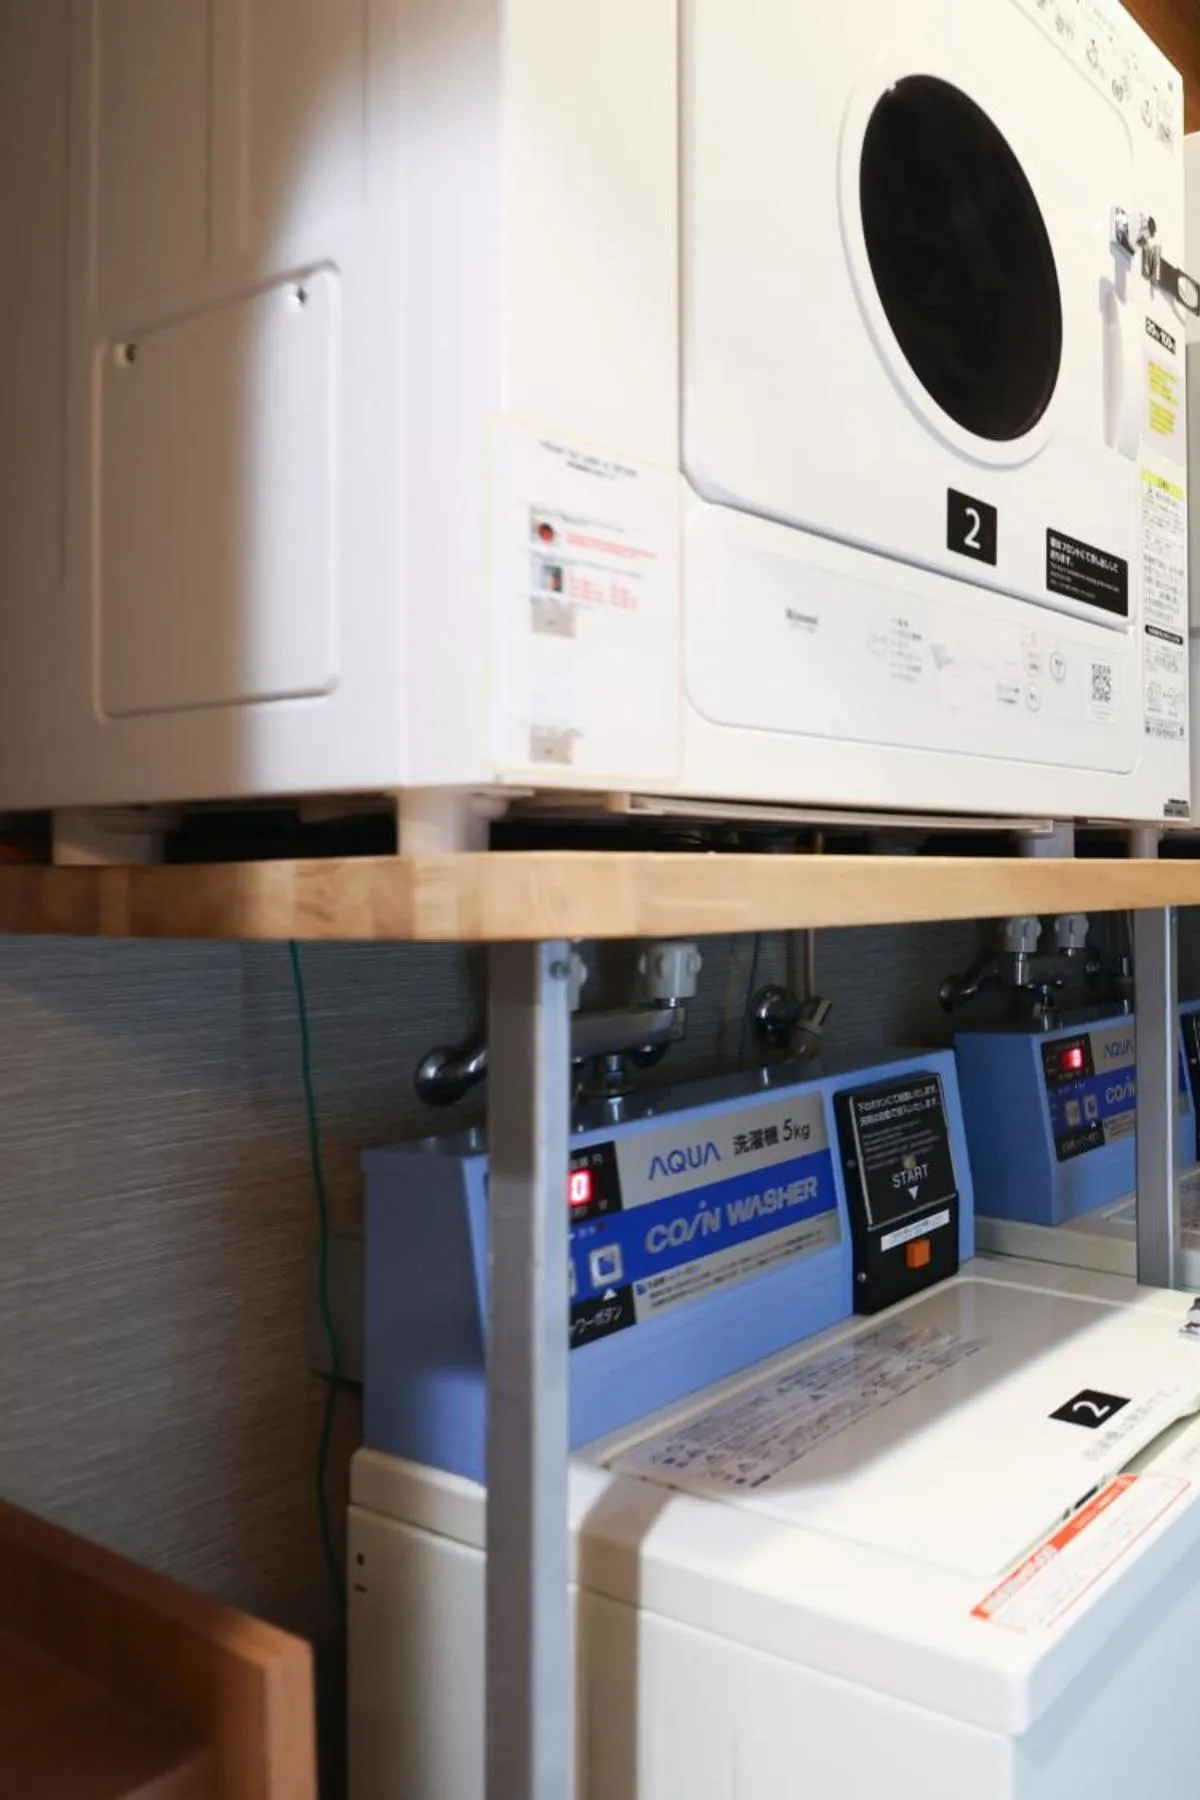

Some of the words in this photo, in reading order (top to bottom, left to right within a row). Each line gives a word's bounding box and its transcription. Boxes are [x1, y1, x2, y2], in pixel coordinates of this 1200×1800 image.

[964, 507, 981, 550] 2
[648, 1141, 722, 1181] AQUA
[732, 1128, 780, 1157] 洗濯機
[783, 1117, 812, 1143] 5kg
[892, 1164, 929, 1189] START
[726, 1176, 818, 1226] WASHER
[1072, 1399, 1110, 1419] 2
